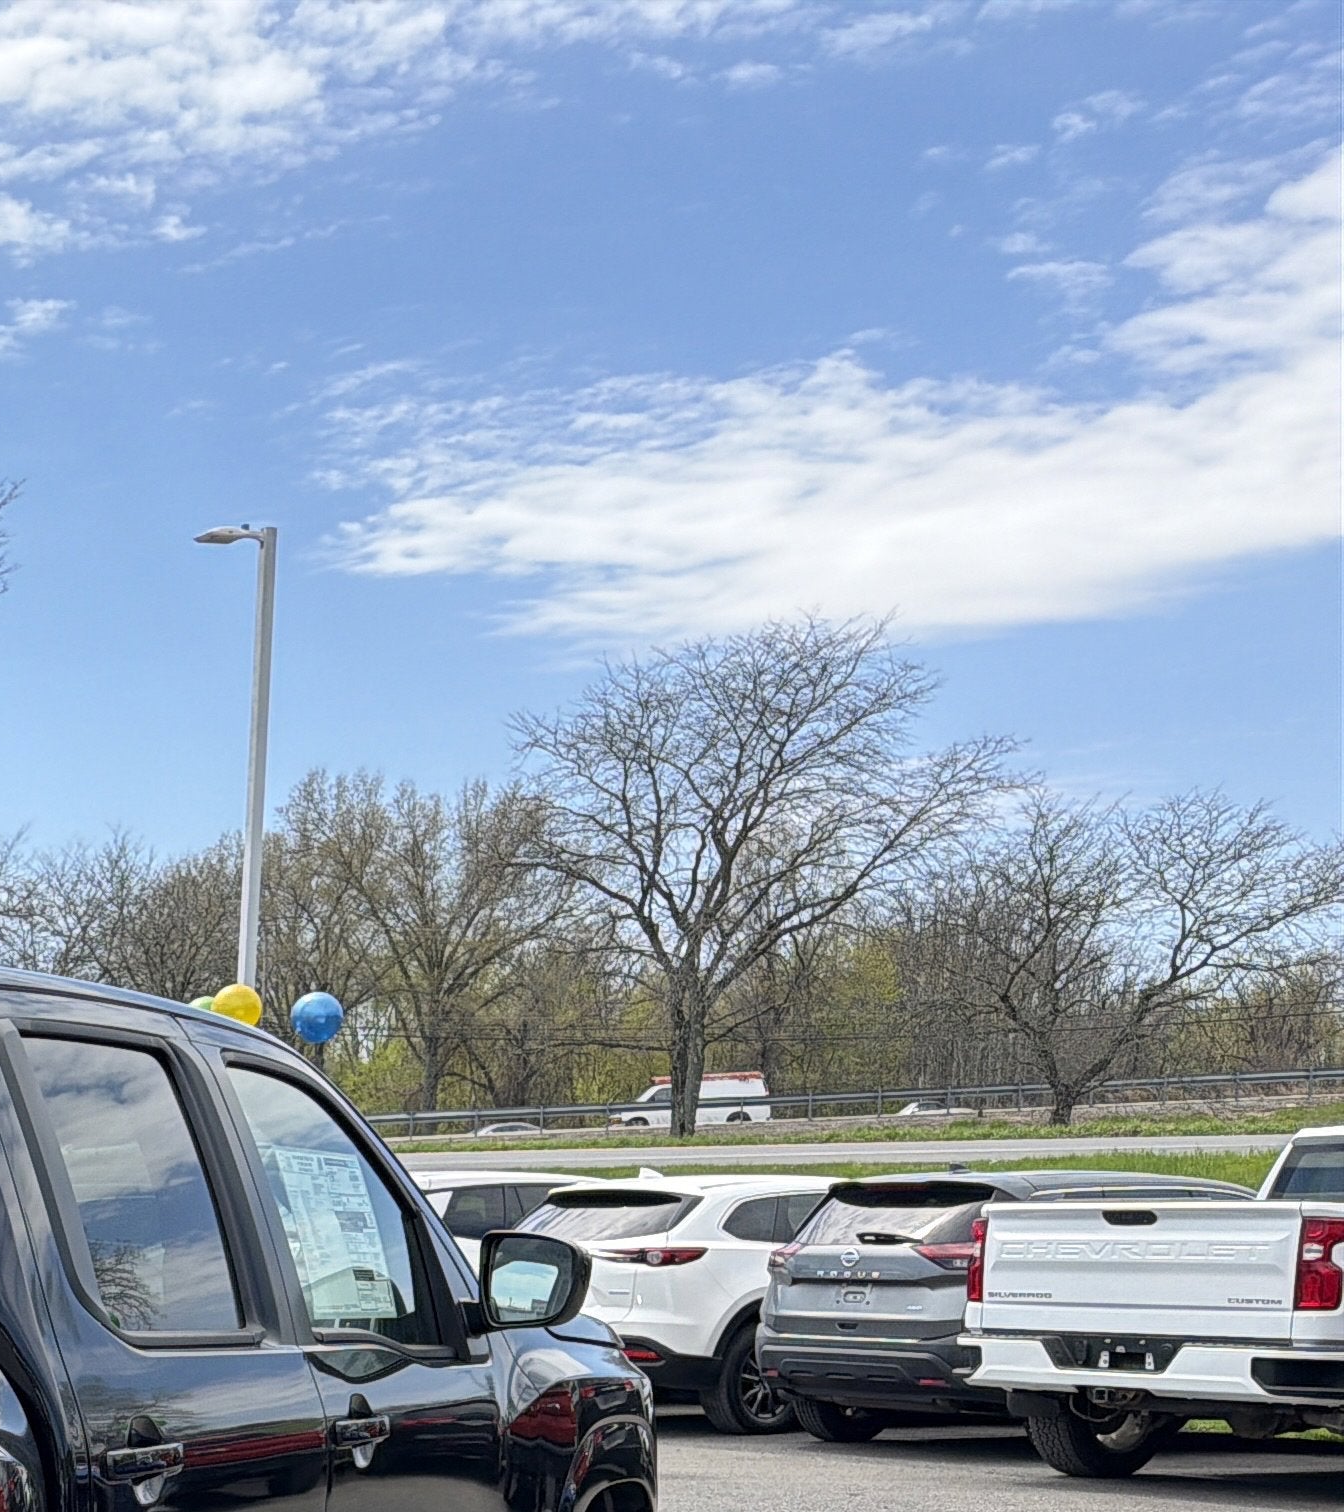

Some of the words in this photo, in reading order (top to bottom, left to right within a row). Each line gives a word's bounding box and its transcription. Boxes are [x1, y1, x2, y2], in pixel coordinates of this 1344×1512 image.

[1000, 1241, 1271, 1261] CHEVROLET
[987, 1291, 1053, 1299] SILVERADO
[1227, 1297, 1283, 1305] CUSTOM
